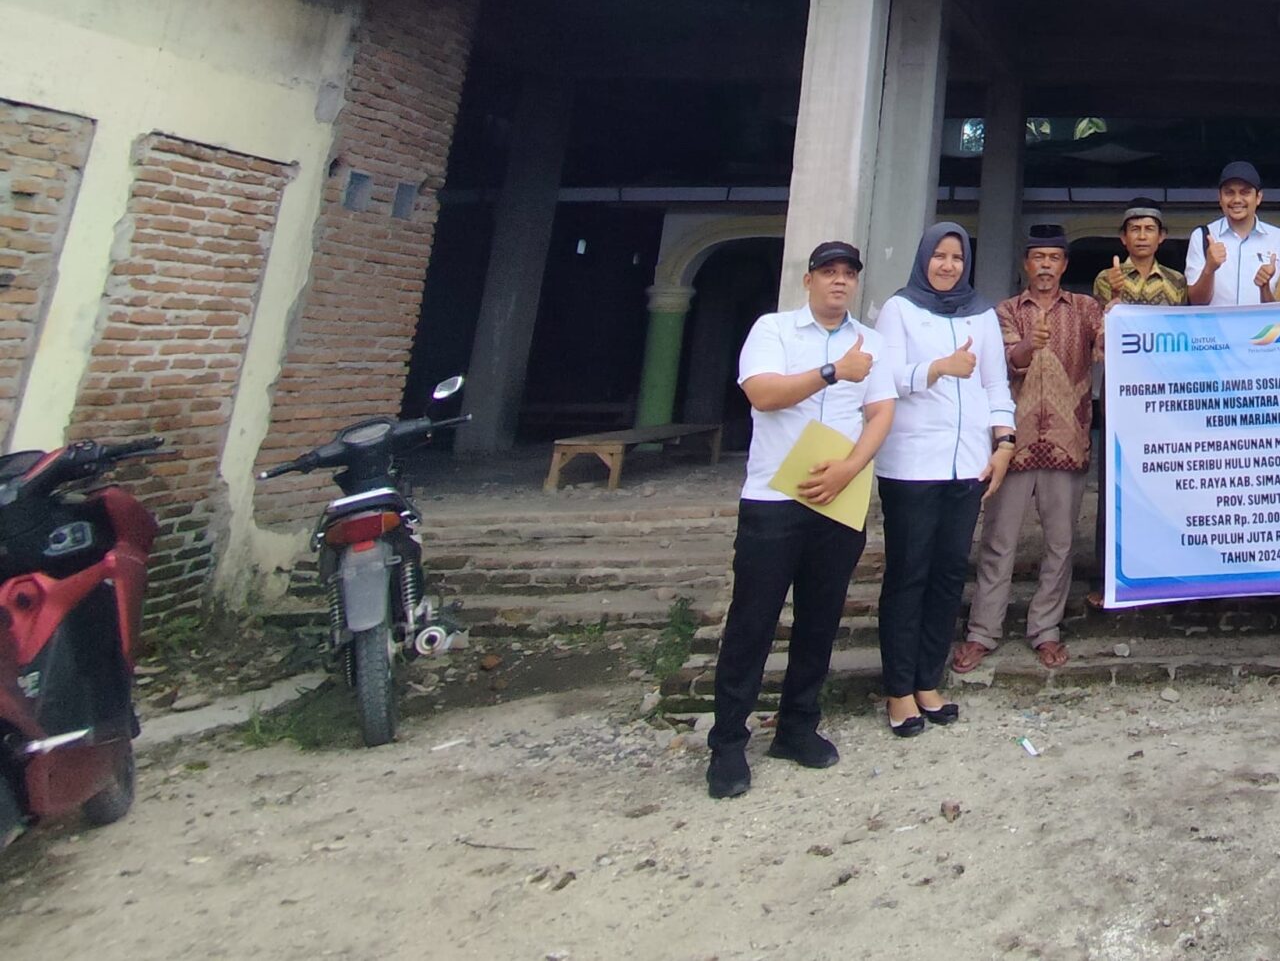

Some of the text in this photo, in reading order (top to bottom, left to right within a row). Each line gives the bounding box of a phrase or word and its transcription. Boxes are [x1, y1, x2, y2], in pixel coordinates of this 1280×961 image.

[1191, 343, 1230, 352] INDONESIA
[1119, 383, 1166, 396] PROGRAM
[1167, 381, 1220, 394] TANGGUNG
[1220, 379, 1254, 392] JAWAB
[1144, 401, 1158, 413] PT
[1158, 398, 1221, 412] PERKEBUNAN
[1222, 395, 1280, 409] NUSANTARA
[1205, 414, 1238, 427] KEBUN
[1143, 442, 1193, 454] BANTUAN
[1193, 438, 1273, 452] PEMBANGUNAN
[1141, 461, 1185, 473] BANGUN
[1186, 459, 1223, 471] SERIBU
[1223, 457, 1252, 469] HULU
[1175, 479, 1199, 490] KEC.
[1199, 477, 1228, 489] RAYA
[1228, 476, 1254, 488] KAB.
[1216, 495, 1246, 507] PROV.
[1185, 514, 1232, 527] SEBESAR
[1233, 514, 1251, 526] Rp.
[1186, 534, 1209, 546] DUA
[1210, 532, 1245, 545] PULUH
[1245, 531, 1274, 543] JUTA
[1220, 551, 1257, 563] TAHUN
